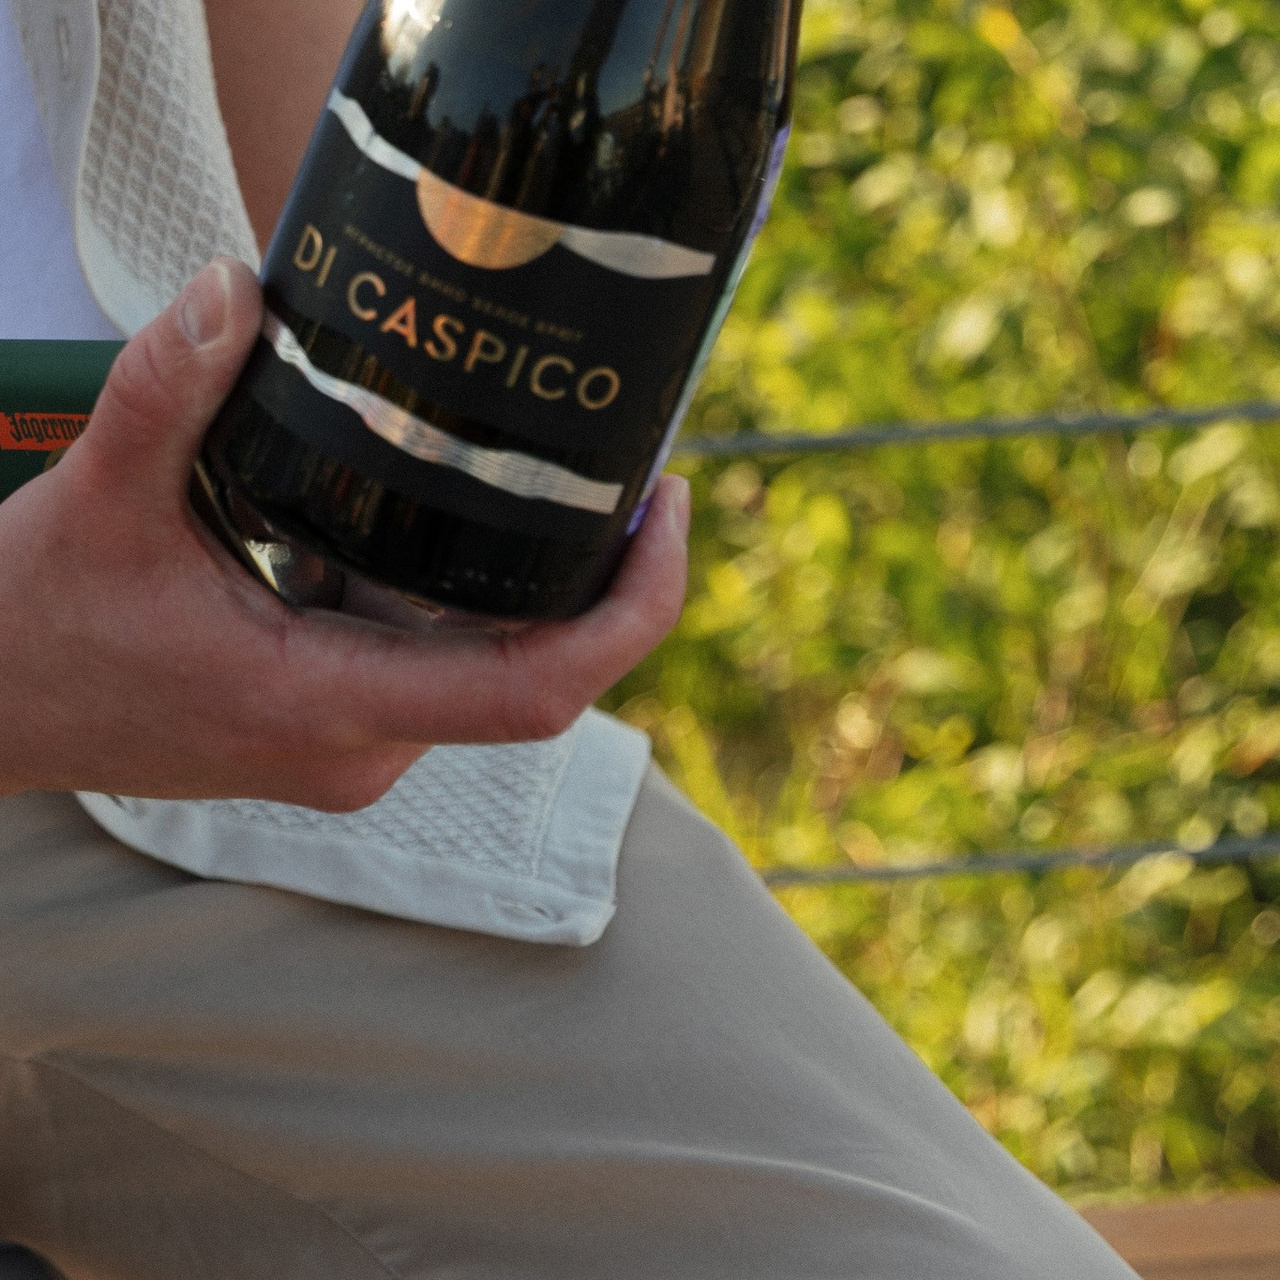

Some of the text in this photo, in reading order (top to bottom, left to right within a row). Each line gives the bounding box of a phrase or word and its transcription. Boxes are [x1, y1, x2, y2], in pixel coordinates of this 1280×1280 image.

[293, 223, 338, 288] DI
[347, 271, 620, 410] CASPICO
[4, 410, 90, 444] Jägerme
